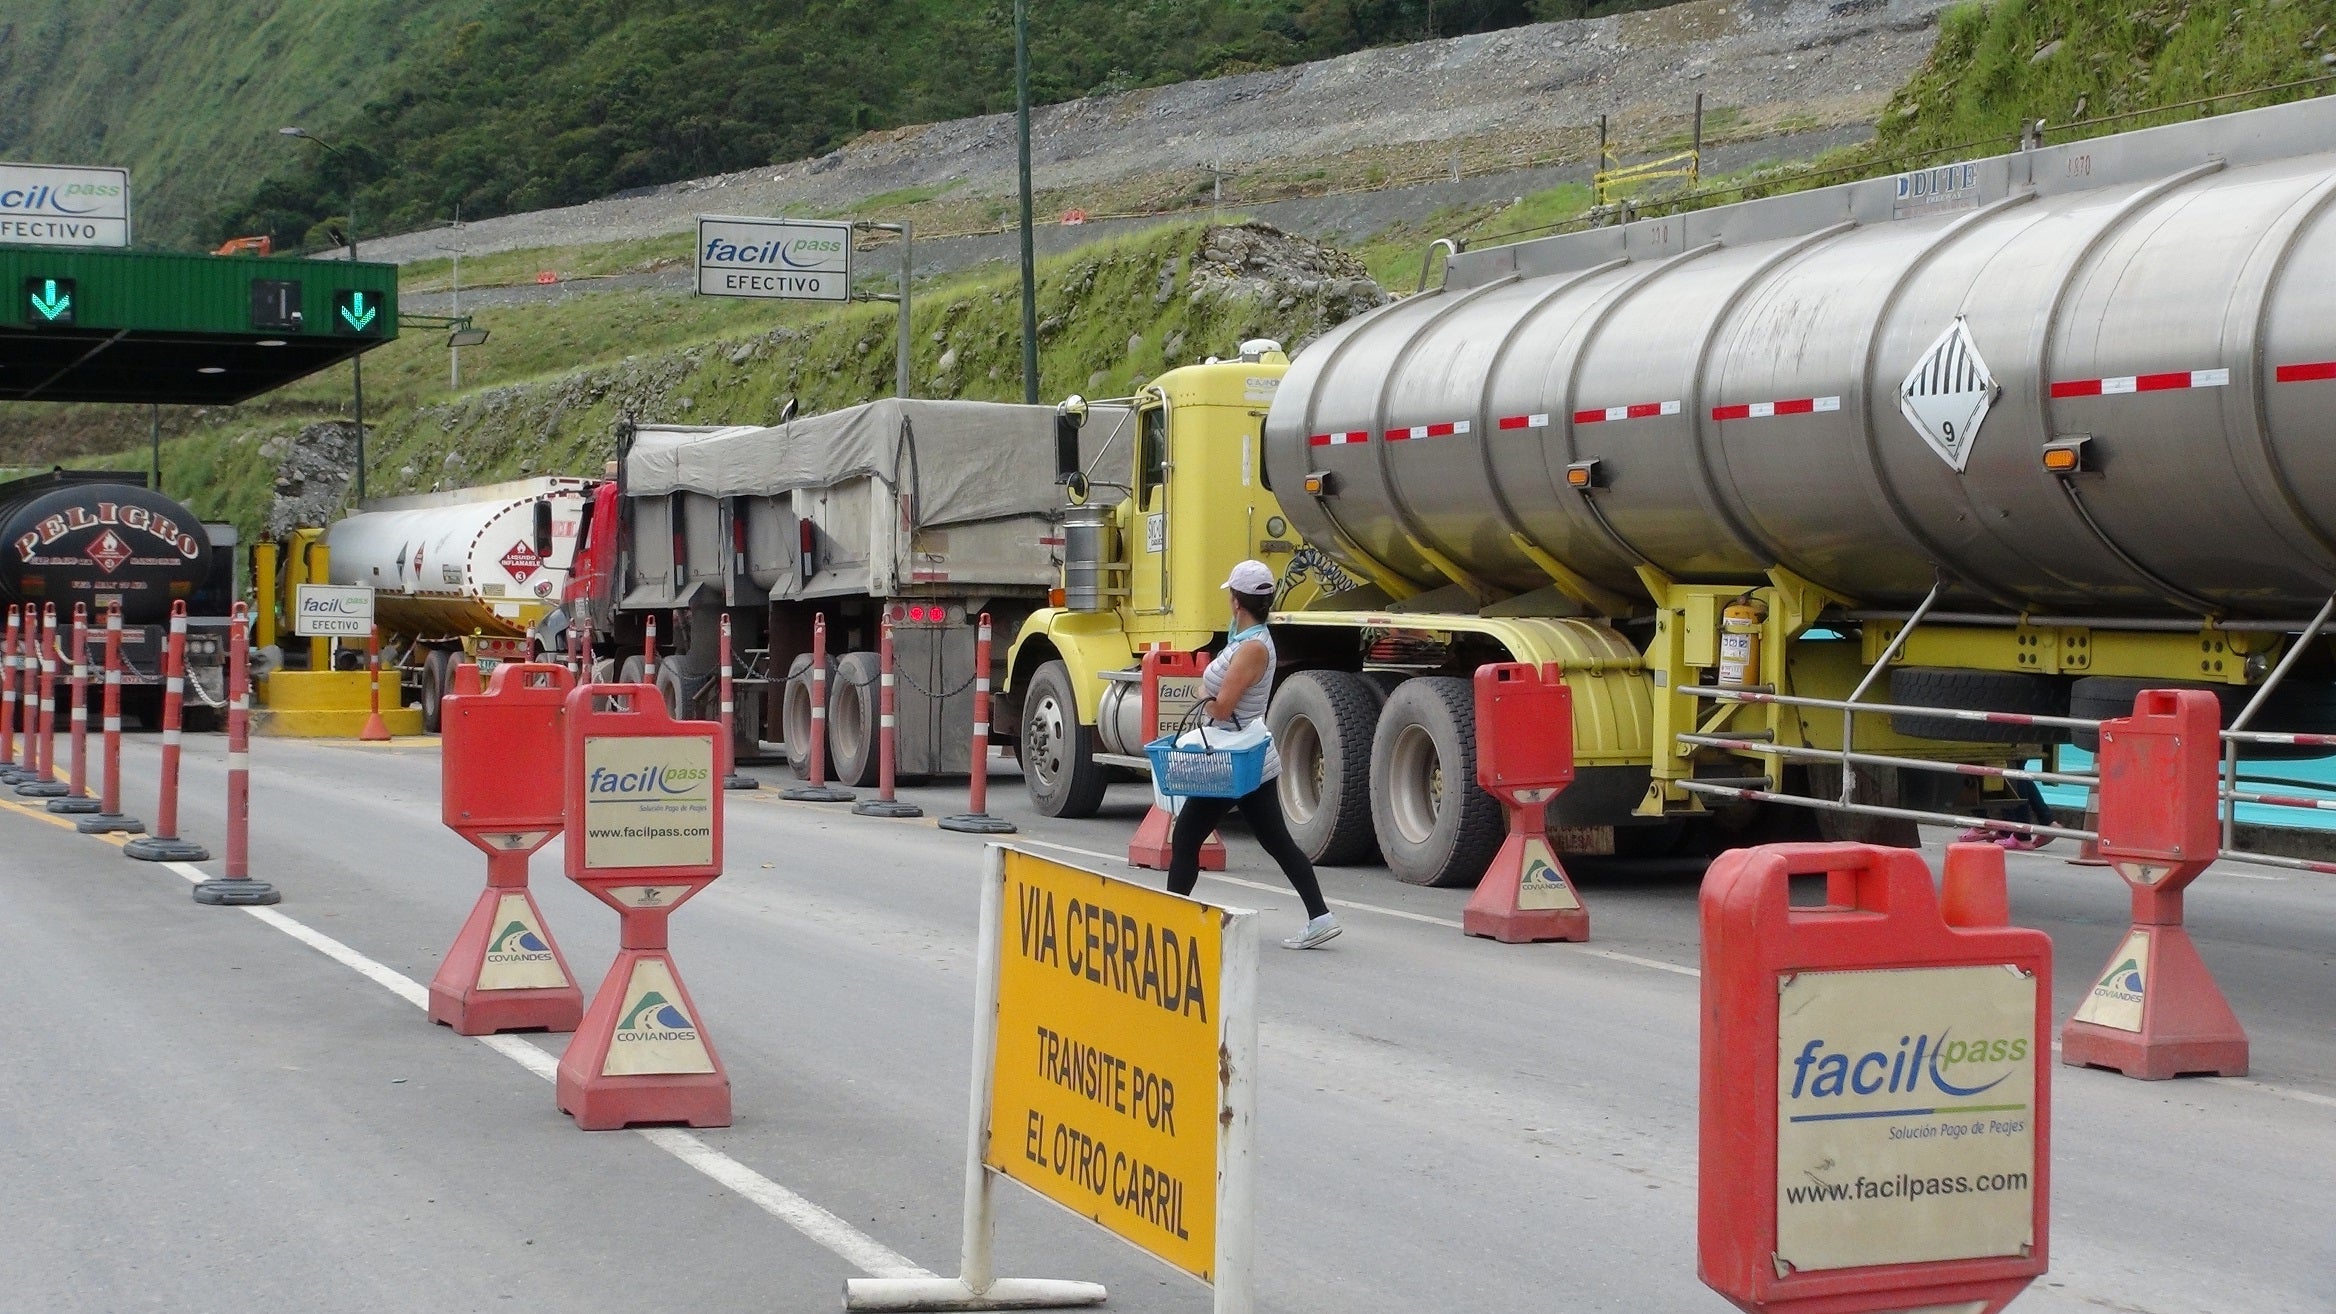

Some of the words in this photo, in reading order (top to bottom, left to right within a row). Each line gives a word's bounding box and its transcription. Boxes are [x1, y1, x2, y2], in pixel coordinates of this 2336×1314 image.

[0, 186, 49, 209] cil
[64, 184, 121, 197] pass
[2, 222, 96, 238] FECTIVO
[706, 239, 781, 264] facil
[793, 239, 841, 253] pass
[726, 275, 821, 292] EFECTIVO
[1942, 421, 1956, 442] 9
[15, 503, 199, 561] PELIGRO
[517, 572, 525, 581] 3
[304, 598, 339, 613] facil
[312, 620, 359, 631] EFECTIVO
[1160, 684, 1190, 698] facil
[1160, 722, 1204, 731] EFECTIV
[590, 766, 658, 794] facil
[664, 768, 708, 784] pass
[589, 827, 710, 840] www.facilpass.com
[1522, 882, 1567, 891] COVIANDES
[488, 953, 553, 963] COVIANDES
[1019, 882, 1059, 968] VIA
[1066, 898, 1208, 1024] CERRADA
[2095, 988, 2142, 1003] COVIANDES
[617, 1031, 696, 1042] COVIANDES
[1791, 1035, 1928, 1099] facil
[1942, 1038, 2028, 1072] pass
[1037, 1025, 1127, 1115] TRANSITE
[1132, 1065, 1176, 1137] POR
[1888, 1124, 1937, 1140] Solución
[1940, 1123, 1968, 1139] Pago
[1970, 1121, 1985, 1134] de
[1989, 1119, 2025, 1138] Peajes
[1026, 1109, 1047, 1168] EL
[1053, 1123, 1107, 1196] OTRO
[1112, 1151, 1189, 1242] CARRIL
[1787, 1171, 2028, 1204] www.facilpass.com
